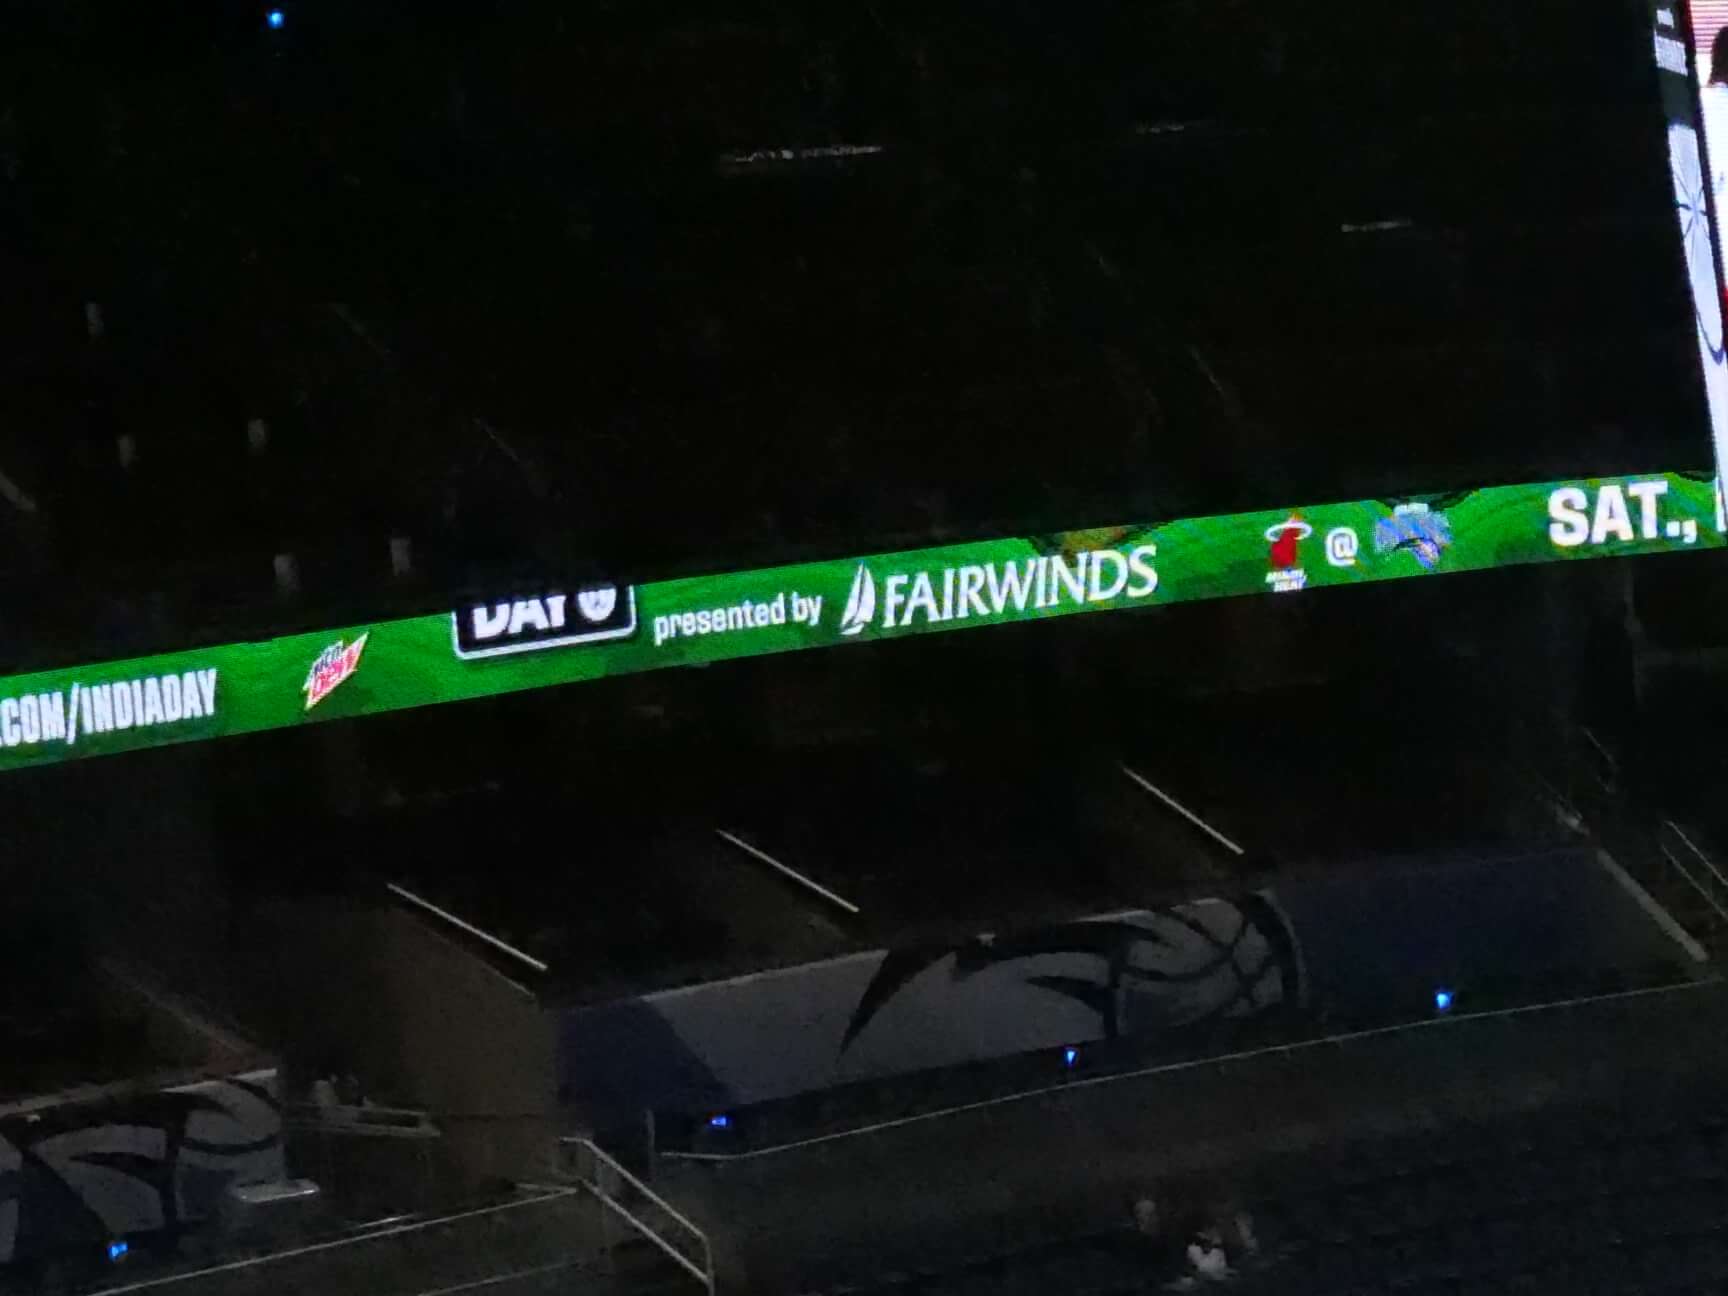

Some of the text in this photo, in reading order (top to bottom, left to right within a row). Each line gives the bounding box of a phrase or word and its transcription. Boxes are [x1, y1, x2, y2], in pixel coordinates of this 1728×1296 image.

[1547, 480, 1698, 547] SAT.,
[1325, 526, 1359, 567] @
[884, 544, 1159, 630] FAIRWINDS
[475, 591, 568, 640] DAY
[653, 590, 823, 646] presented by
